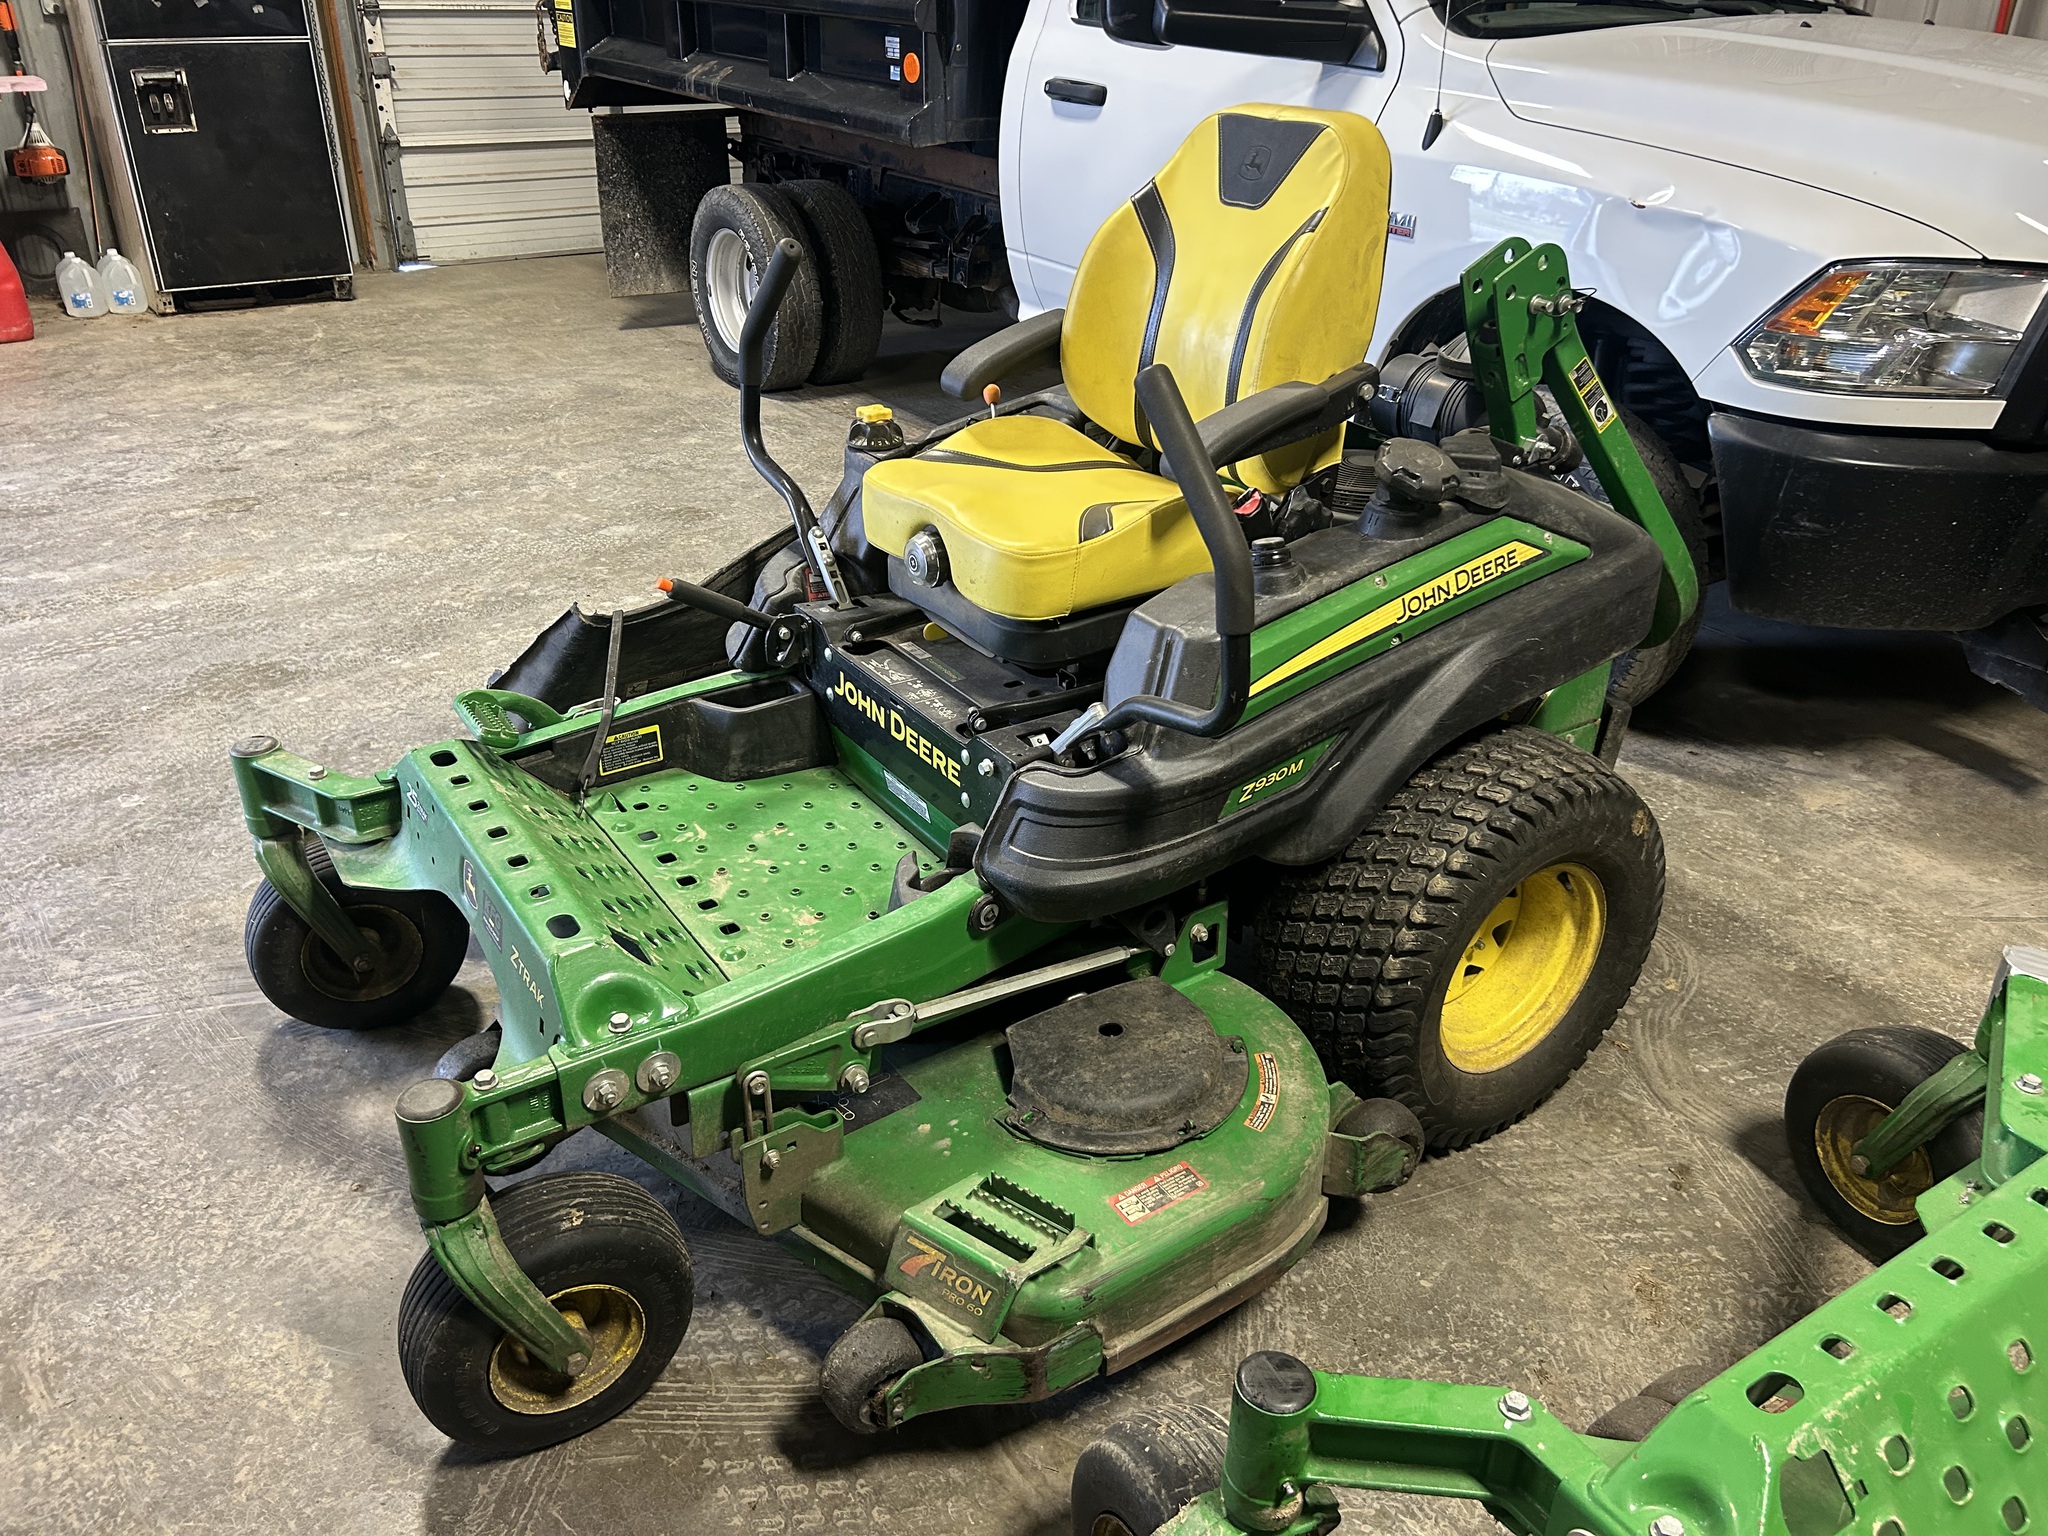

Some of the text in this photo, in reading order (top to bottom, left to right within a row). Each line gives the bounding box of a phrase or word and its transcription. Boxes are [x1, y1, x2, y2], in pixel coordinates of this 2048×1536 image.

[1395, 548, 1519, 625] JOHN DEERE
[834, 670, 963, 788] JOHN DEERE
[1238, 758, 1304, 804] Z930M
[509, 944, 546, 1010] ZTRAK
[1124, 1182, 1148, 1196] DANGER
[1159, 1163, 1184, 1178] PELIGRO
[930, 1260, 993, 1306] IRON
[941, 1288, 983, 1316] PRO 60
